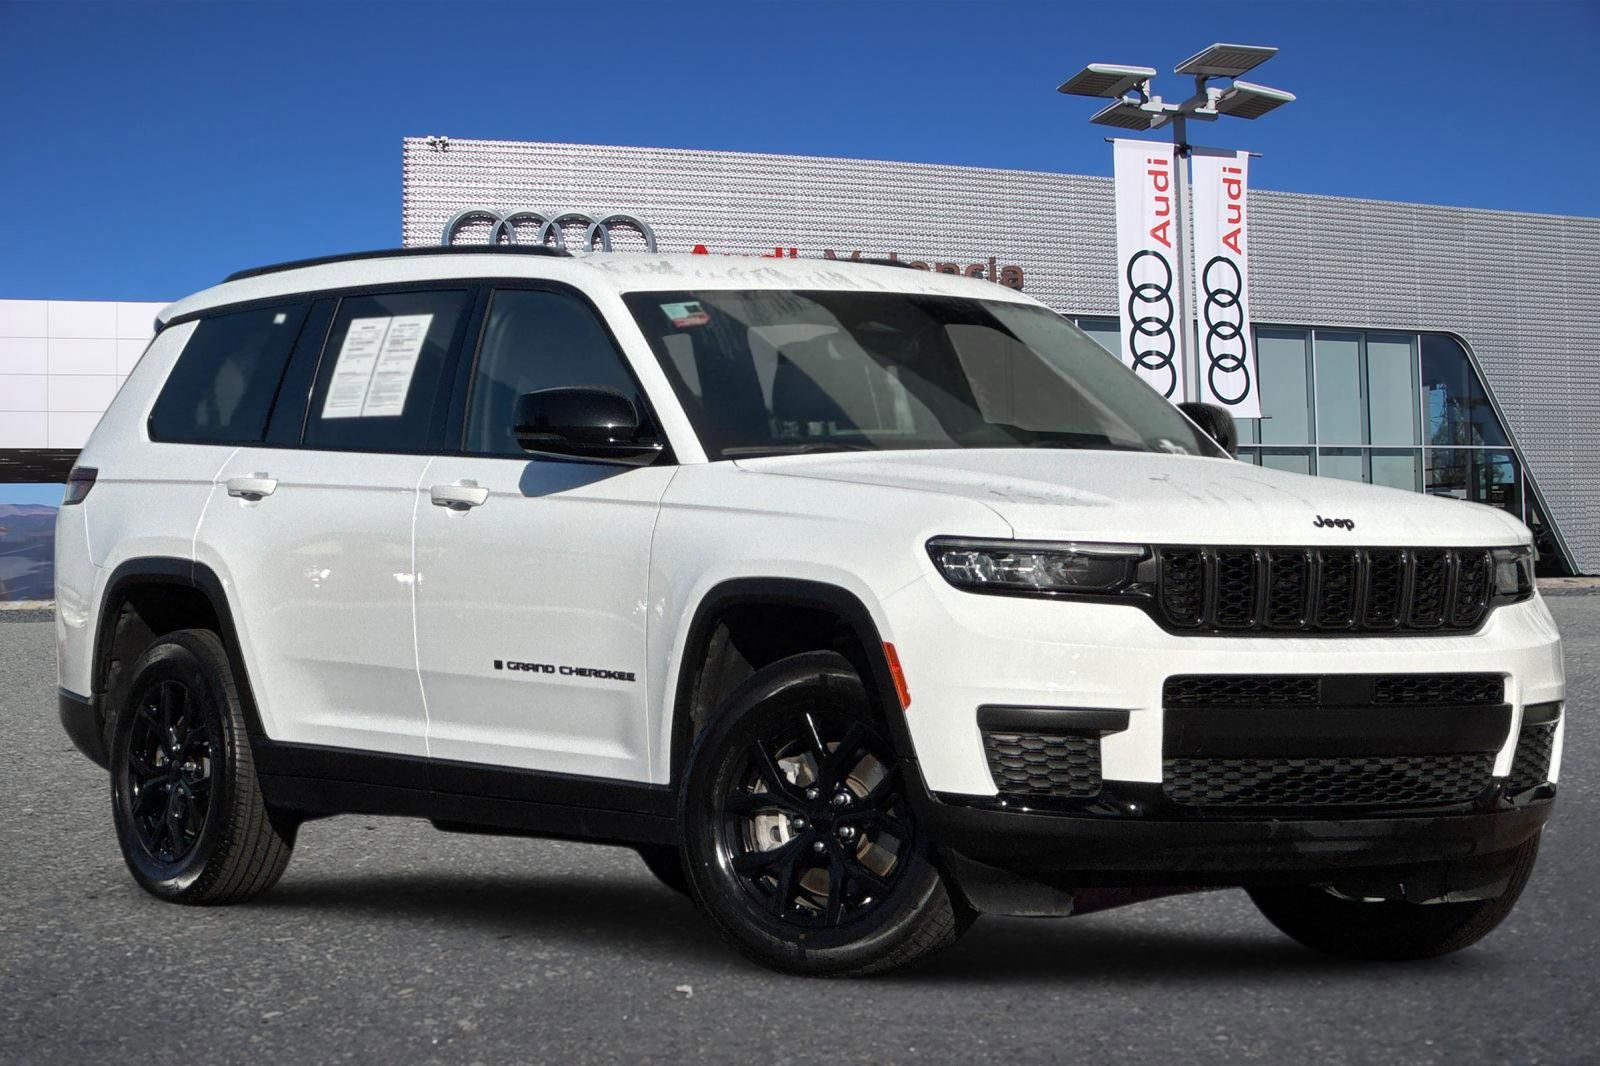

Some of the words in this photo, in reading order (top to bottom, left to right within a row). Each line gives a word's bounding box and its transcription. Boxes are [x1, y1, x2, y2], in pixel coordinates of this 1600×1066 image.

[1147, 158, 1171, 248] Audi
[1223, 166, 1242, 255] Audi
[1313, 515, 1355, 531] Jeep
[506, 661, 556, 674] GRAND
[558, 665, 636, 682] CHEROKEE
